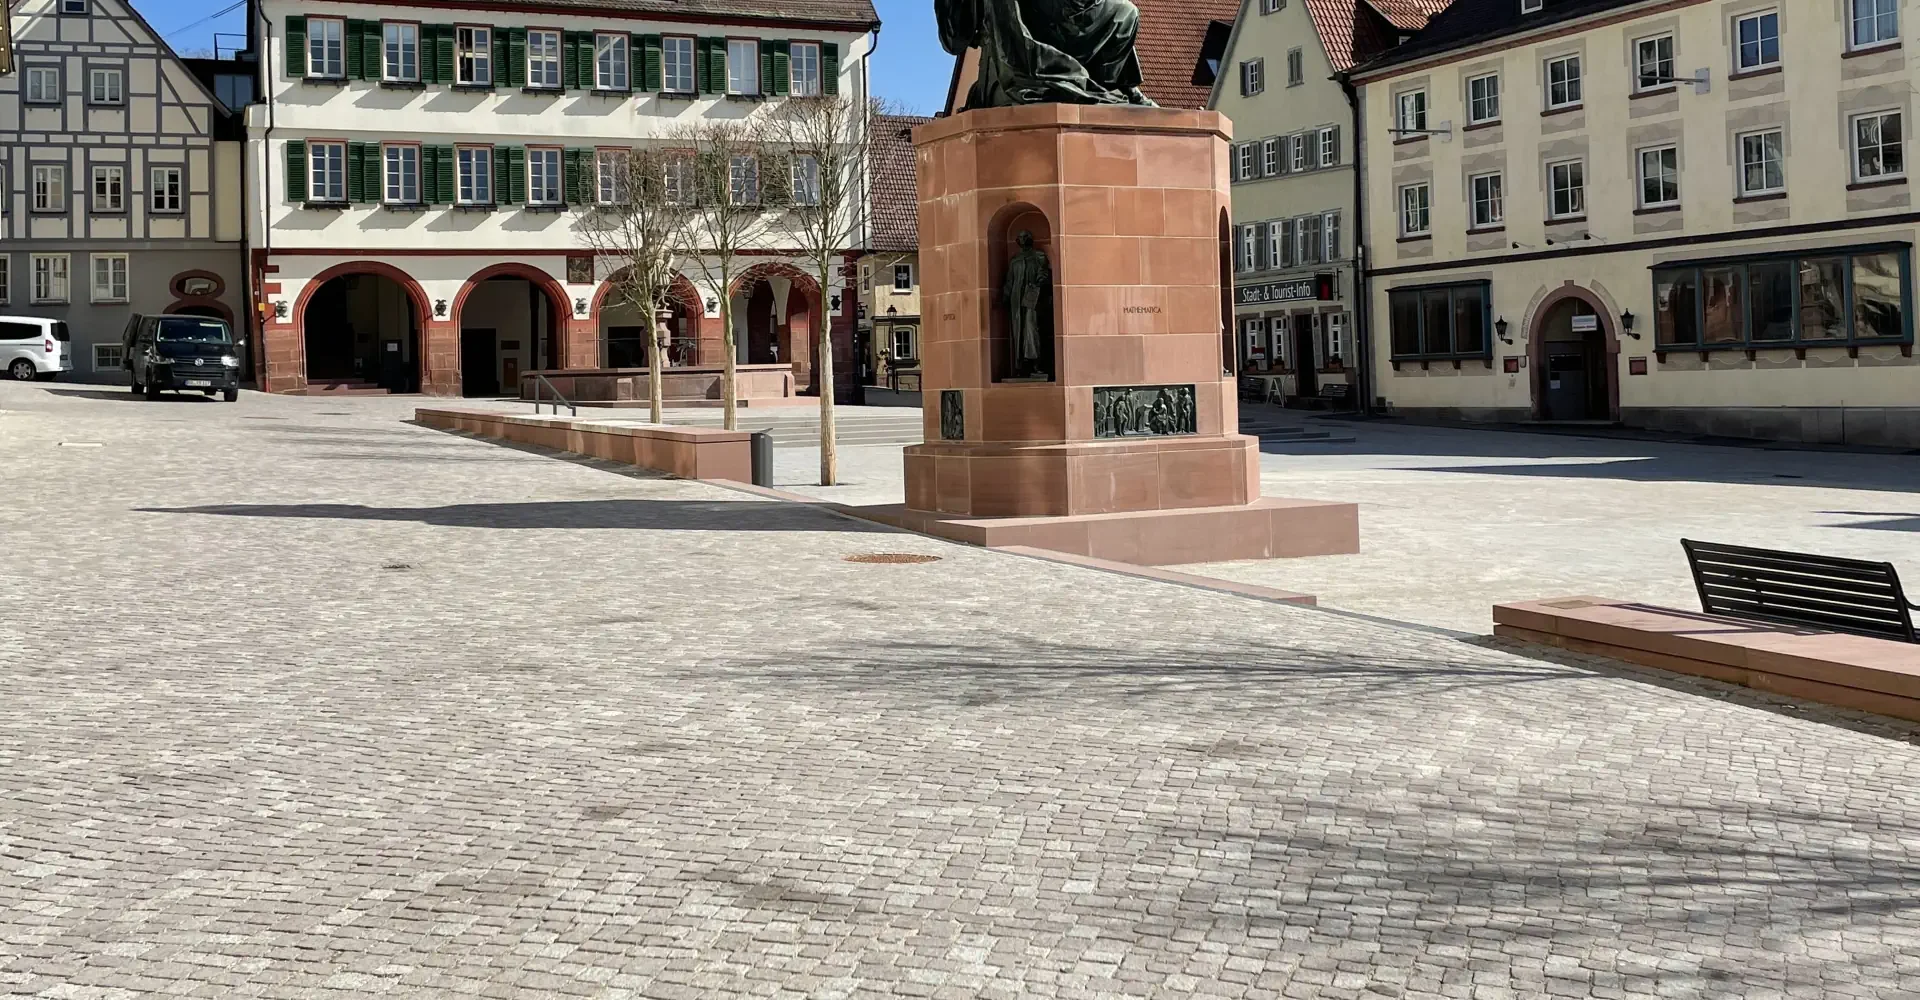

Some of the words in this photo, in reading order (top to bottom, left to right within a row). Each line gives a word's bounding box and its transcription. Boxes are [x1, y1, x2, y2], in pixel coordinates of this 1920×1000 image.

[1242, 287, 1262, 302] Stadt-
[1263, 285, 1270, 300] &
[1271, 281, 1311, 299] Tourist-Info
[1123, 306, 1162, 314] MATHEMATICA
